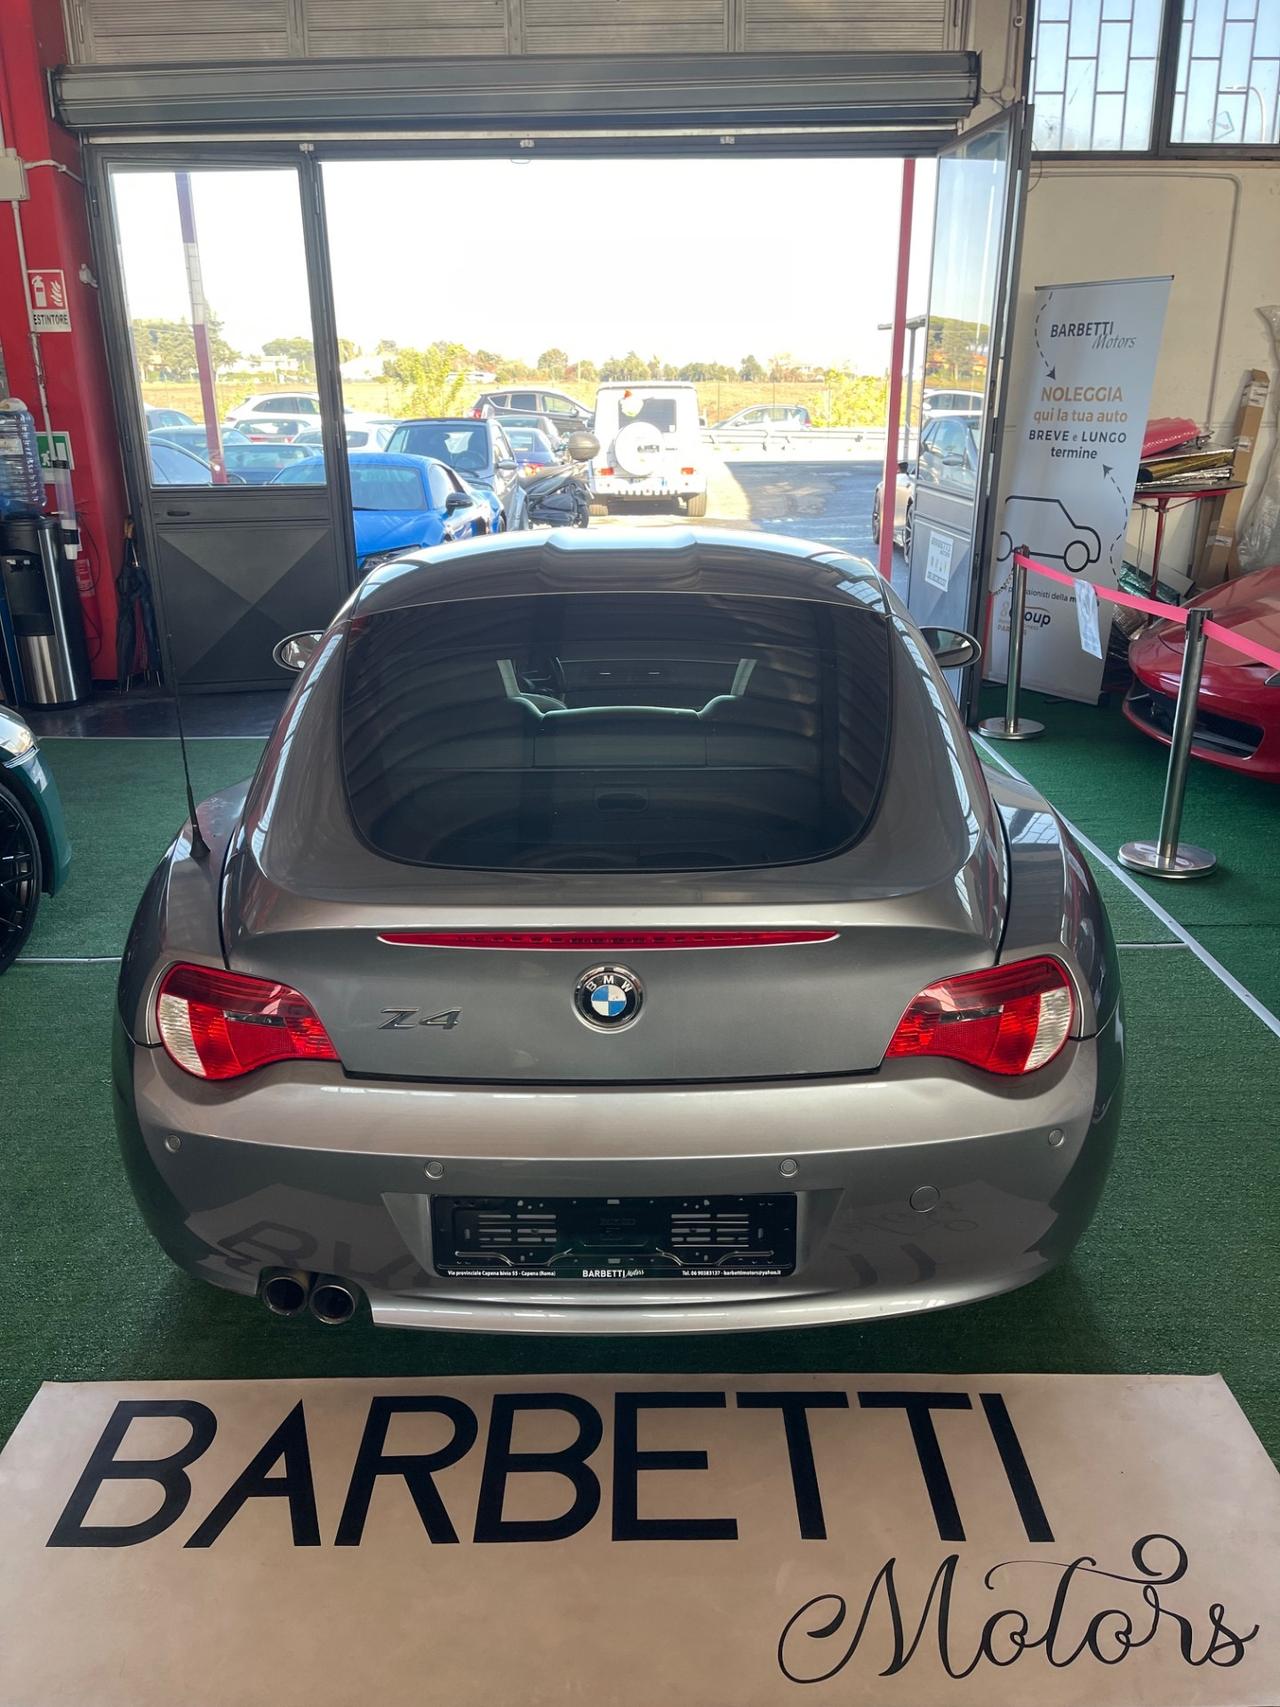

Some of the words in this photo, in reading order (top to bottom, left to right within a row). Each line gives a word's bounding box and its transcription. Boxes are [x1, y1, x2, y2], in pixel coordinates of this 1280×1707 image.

[33, 314, 69, 325] ESTINTORE
[1050, 321, 1114, 338] BARBETTI
[1091, 333, 1137, 350] Motors
[1040, 386, 1123, 402] NOLEGGIA
[1033, 408, 1054, 425] qui
[1057, 408, 1069, 422] la
[1072, 410, 1094, 422] tua
[1096, 410, 1128, 423] auto
[1028, 429, 1070, 441] BREVE
[1072, 434, 1078, 442] e
[1081, 431, 1127, 443] LUNGO
[1050, 446, 1098, 460] termine
[1051, 593, 1068, 602] della
[586, 975, 633, 992] BMW
[376, 1006, 463, 1030] Z4
[582, 1269, 626, 1278] BARBETTI
[45, 1391, 1056, 1549] BARBETTI
[778, 1533, 1260, 1685] Motors
